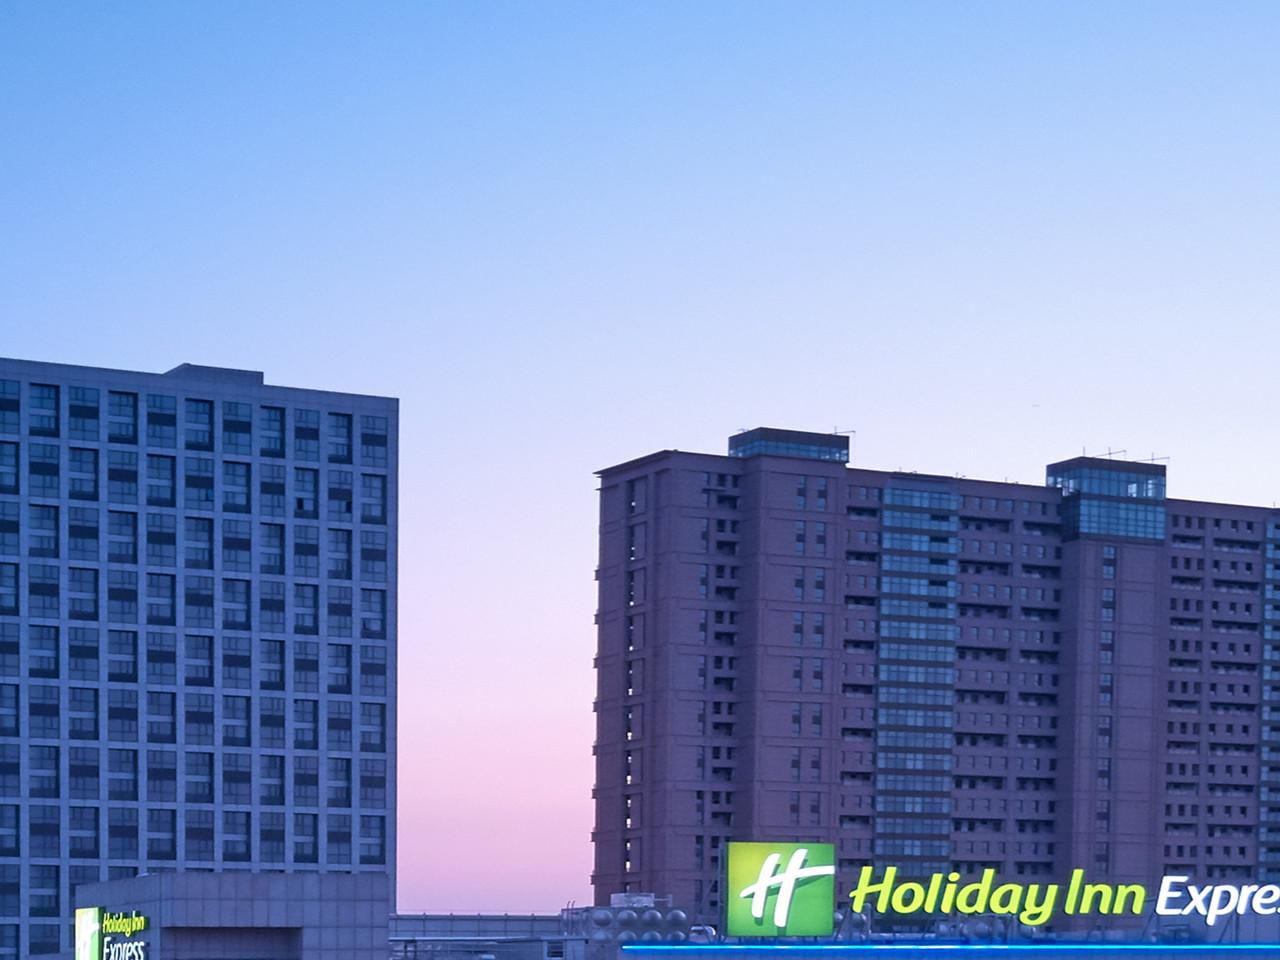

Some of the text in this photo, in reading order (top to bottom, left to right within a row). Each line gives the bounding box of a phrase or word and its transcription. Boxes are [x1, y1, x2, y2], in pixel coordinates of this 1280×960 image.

[849, 866, 1058, 926] Holiday
[1064, 868, 1147, 915] Inn
[102, 912, 131, 937] Holiday
